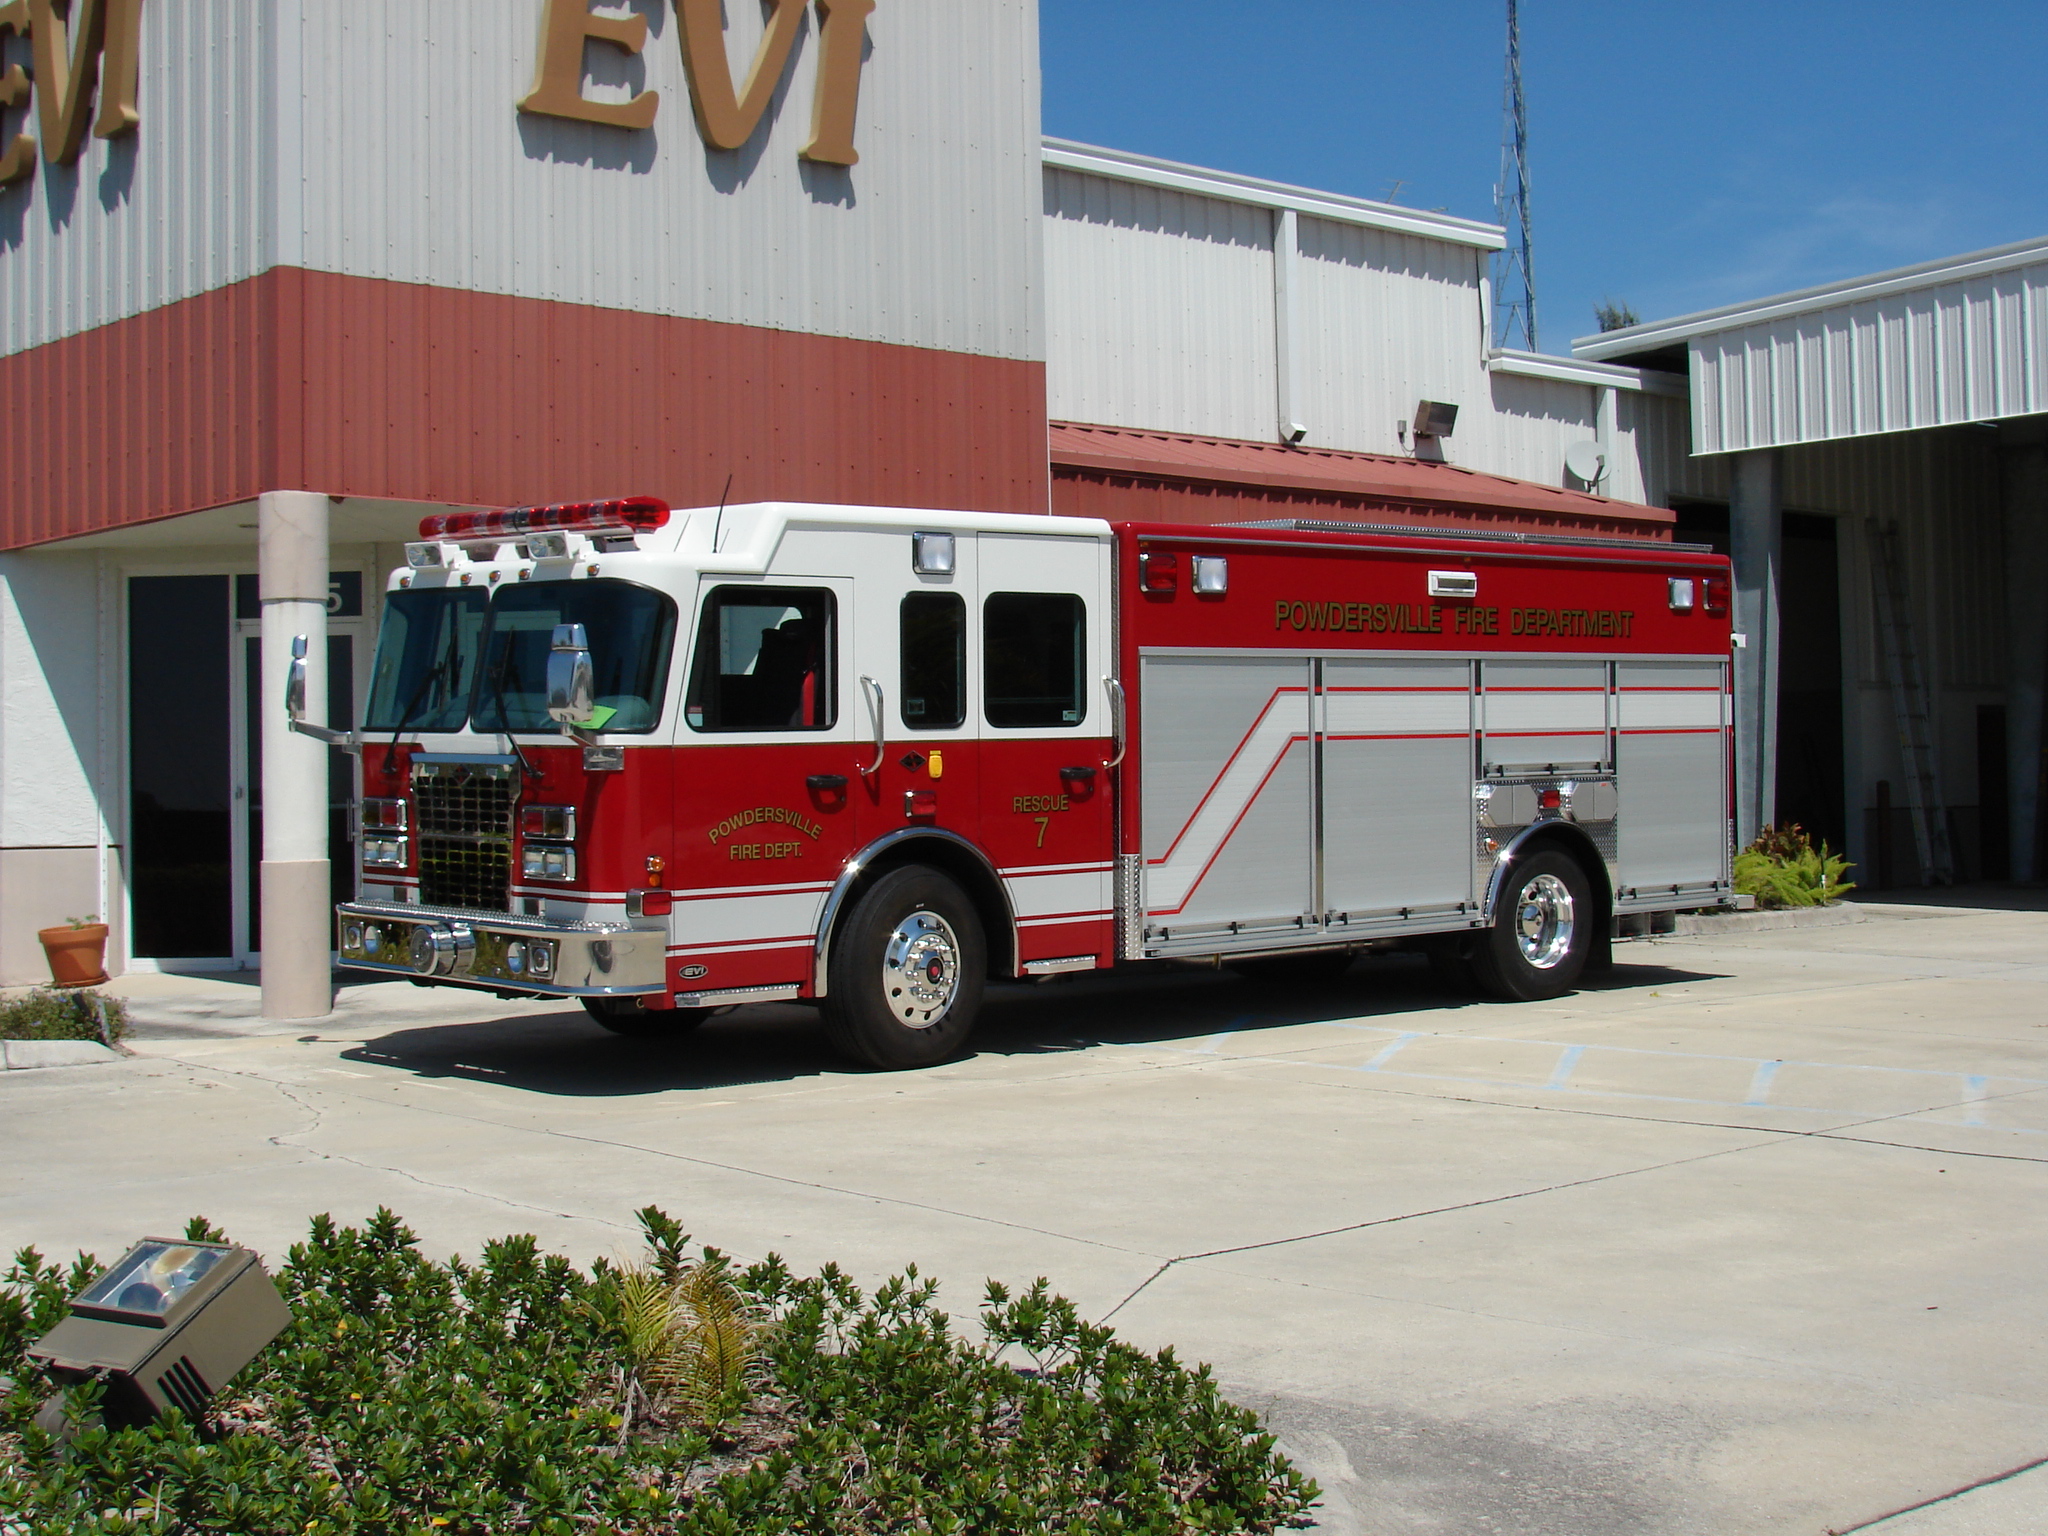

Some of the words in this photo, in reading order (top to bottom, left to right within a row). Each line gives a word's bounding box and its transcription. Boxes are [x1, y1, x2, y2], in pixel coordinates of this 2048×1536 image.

[516, 0, 876, 165] EVI
[1275, 600, 1442, 634] POWDERSVILLE
[1455, 606, 1499, 635] FIRE
[1510, 608, 1634, 637] DEPARTMENT
[1013, 794, 1069, 813] RESCUE
[708, 807, 822, 845] POWDERSVILLE
[1034, 816, 1049, 848] 7
[730, 844, 761, 860] FIRE
[764, 842, 802, 858] DEPT.
